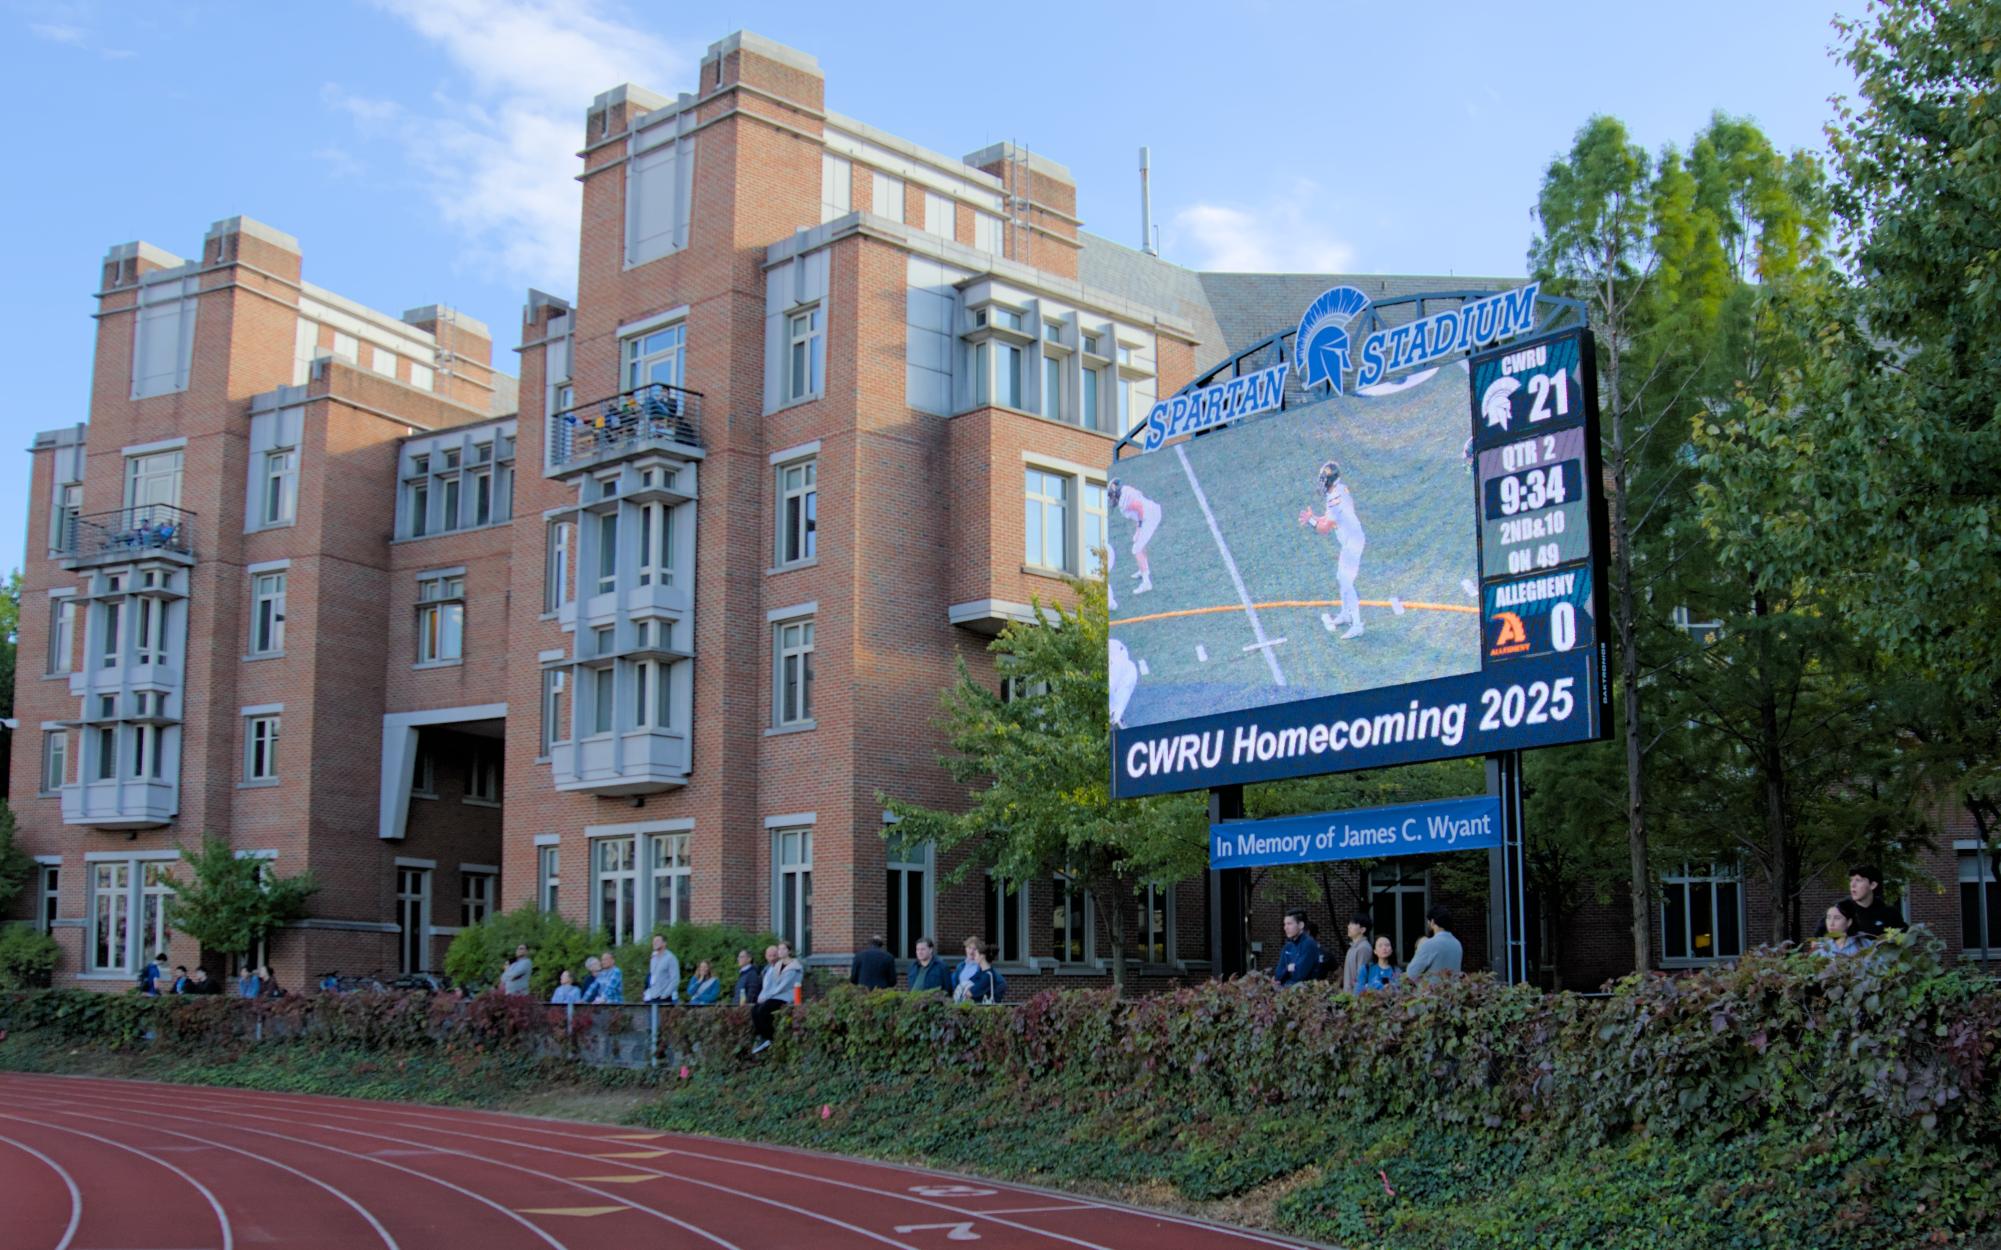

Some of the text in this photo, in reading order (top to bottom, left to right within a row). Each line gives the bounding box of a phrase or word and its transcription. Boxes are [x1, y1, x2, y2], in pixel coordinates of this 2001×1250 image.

[1144, 282, 1540, 452] SPARTAN STADIUM
[1502, 345, 1547, 376] CWRU
[1528, 368, 1568, 422] 21
[1502, 435, 1556, 471] QTR 2
[1501, 465, 1566, 515] 9:34
[1508, 542, 1559, 574] ON 49
[1495, 573, 1575, 608] ALLEGHENY
[1551, 601, 1576, 652] 0
[1126, 676, 1574, 778] CWRU Homecoming 2025
[1216, 814, 1491, 857] In Memory of James C. Wyant
